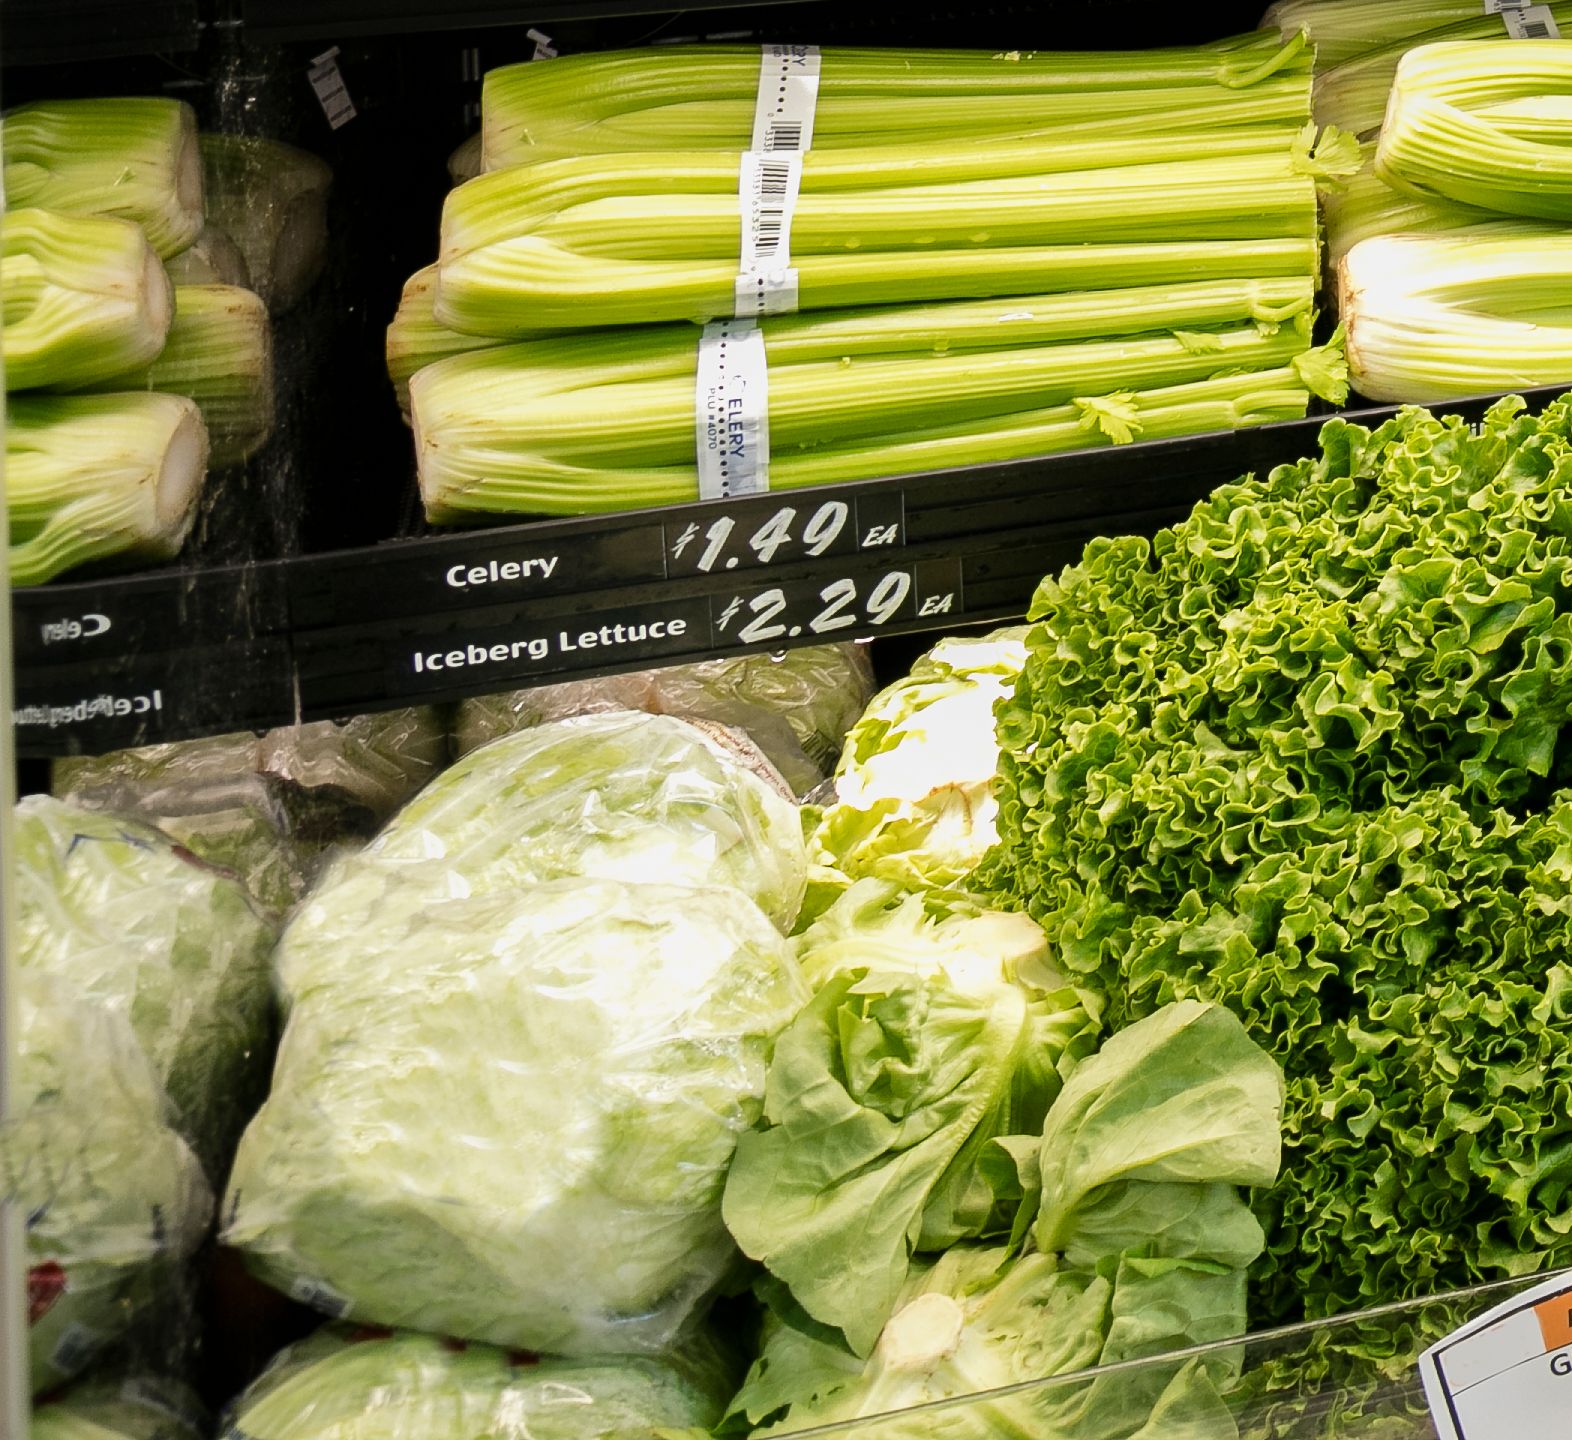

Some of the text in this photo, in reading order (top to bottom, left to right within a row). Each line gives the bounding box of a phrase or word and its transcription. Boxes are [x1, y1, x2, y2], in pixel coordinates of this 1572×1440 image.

[673, 500, 897, 574] $1.49 EA
[446, 552, 559, 589] Celery
[413, 614, 688, 675] Iceberg Lettuce
